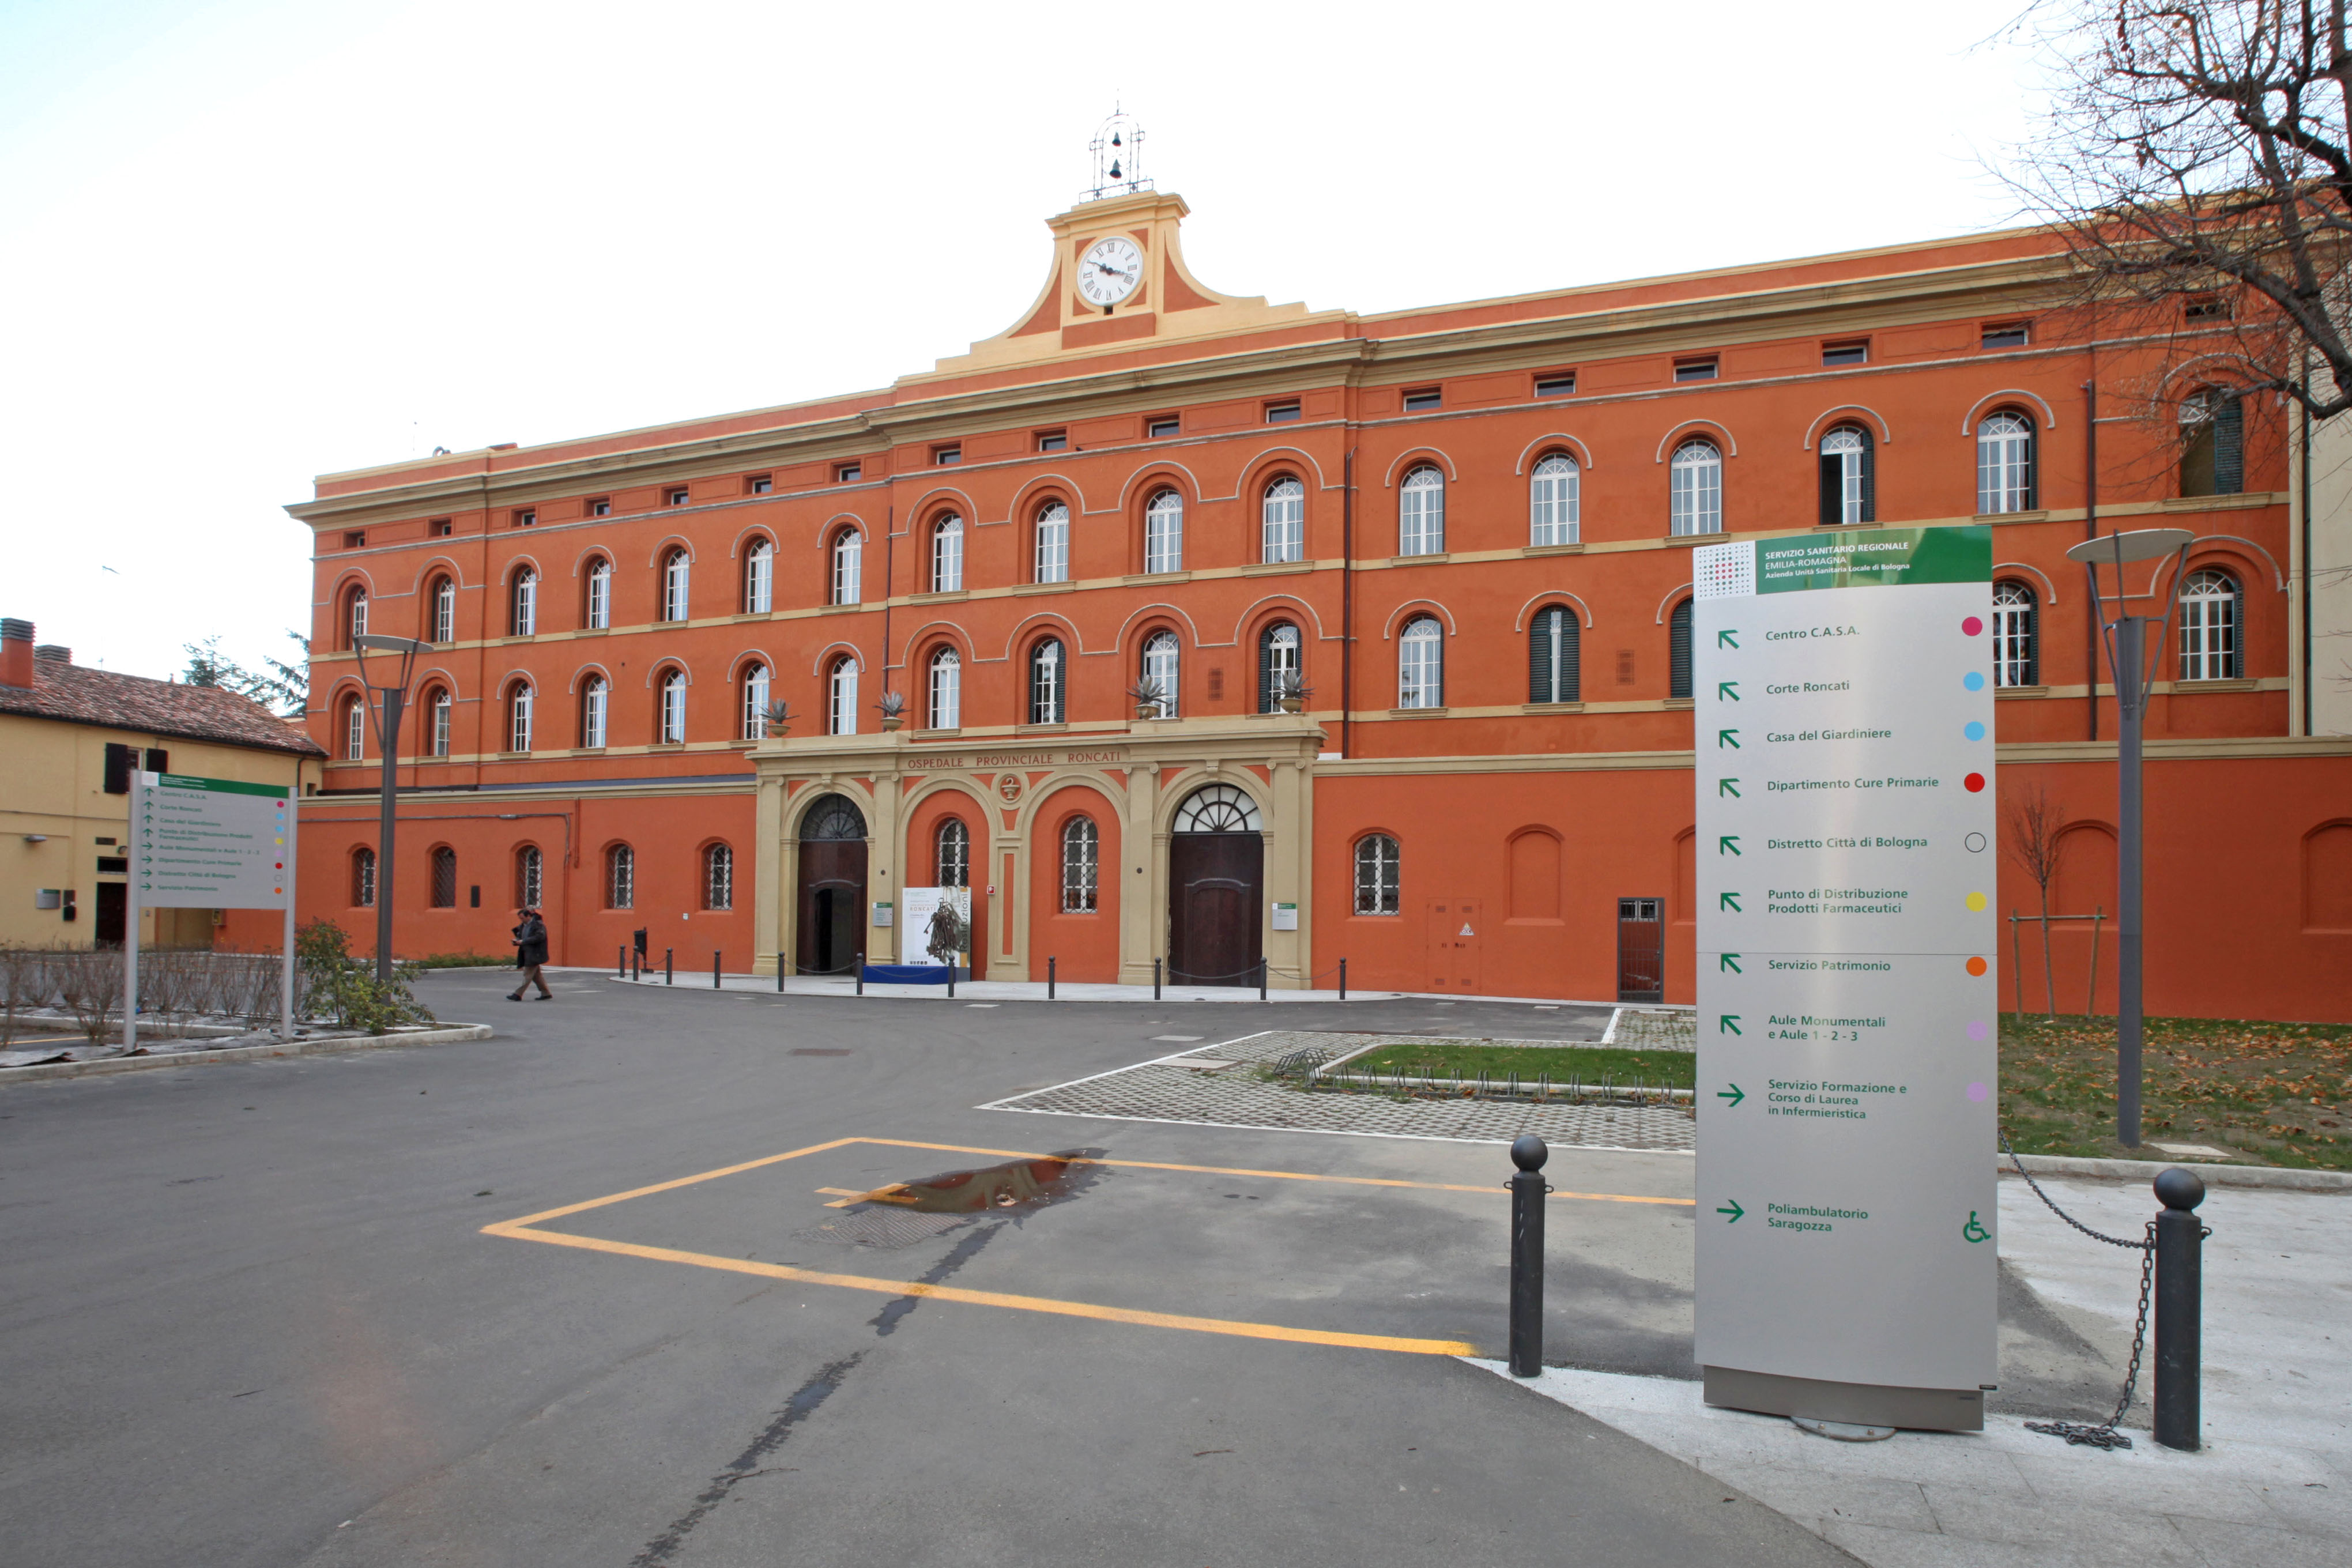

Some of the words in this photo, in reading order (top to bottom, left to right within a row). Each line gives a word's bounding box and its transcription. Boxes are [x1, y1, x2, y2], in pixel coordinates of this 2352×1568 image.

[1765, 549, 1804, 560] SERVIZIO
[1807, 545, 1855, 556] SANITARIO
[1858, 542, 1909, 552] REGIONALE
[1765, 556, 1847, 570] EMILIA-ROMAGNA
[1765, 571, 1793, 579] Azienda
[1766, 628, 1807, 641] Centro
[1811, 625, 1860, 638] C.A.S.A.
[1766, 684, 1800, 695] Corte
[1803, 680, 1850, 692] Roncati
[1766, 733, 1795, 742] Casa
[1799, 730, 1818, 741] del
[1821, 728, 1891, 740] Giardiniere
[908, 758, 964, 768] OSPEDALE
[977, 754, 1054, 767] PROVINCIALE
[1068, 751, 1121, 763] RONCATI
[1767, 779, 1850, 793] Dipartimento
[1854, 778, 1884, 789] Cure
[1887, 777, 1939, 787] Primarie
[1767, 839, 1823, 849] Distretto
[1826, 837, 1856, 848] Città
[1860, 836, 1872, 847] di
[1876, 836, 1928, 850] Bologna
[1768, 889, 1805, 899] Punto
[1808, 888, 1820, 899] di
[1825, 888, 1908, 899] Distribuzione
[1768, 903, 1818, 914] Prodotti
[1823, 903, 1902, 913] Farmaceutici
[1769, 959, 1818, 970] Servizio
[1821, 960, 1891, 971] Patrimonio
[1768, 1015, 1797, 1026] Aule
[1801, 1016, 1886, 1027] Monumentali
[1768, 1031, 1776, 1039] e
[1780, 1029, 1808, 1040] Aule
[1813, 1031, 1818, 1039] 1
[1831, 1031, 1839, 1041] 2
[1851, 1031, 1858, 1041] 3
[1768, 1079, 1818, 1091] Servizio
[1822, 1081, 1896, 1094] Formazione
[1899, 1085, 1907, 1094] e
[1768, 1092, 1801, 1103] Corso
[1804, 1094, 1815, 1103] di
[1819, 1095, 1859, 1105] Laurea
[1768, 1105, 1779, 1115] in
[1782, 1106, 1866, 1119] Infermieristica
[1768, 1203, 1869, 1219] Poliambulatorio
[1768, 1218, 1832, 1232] Saragozza
